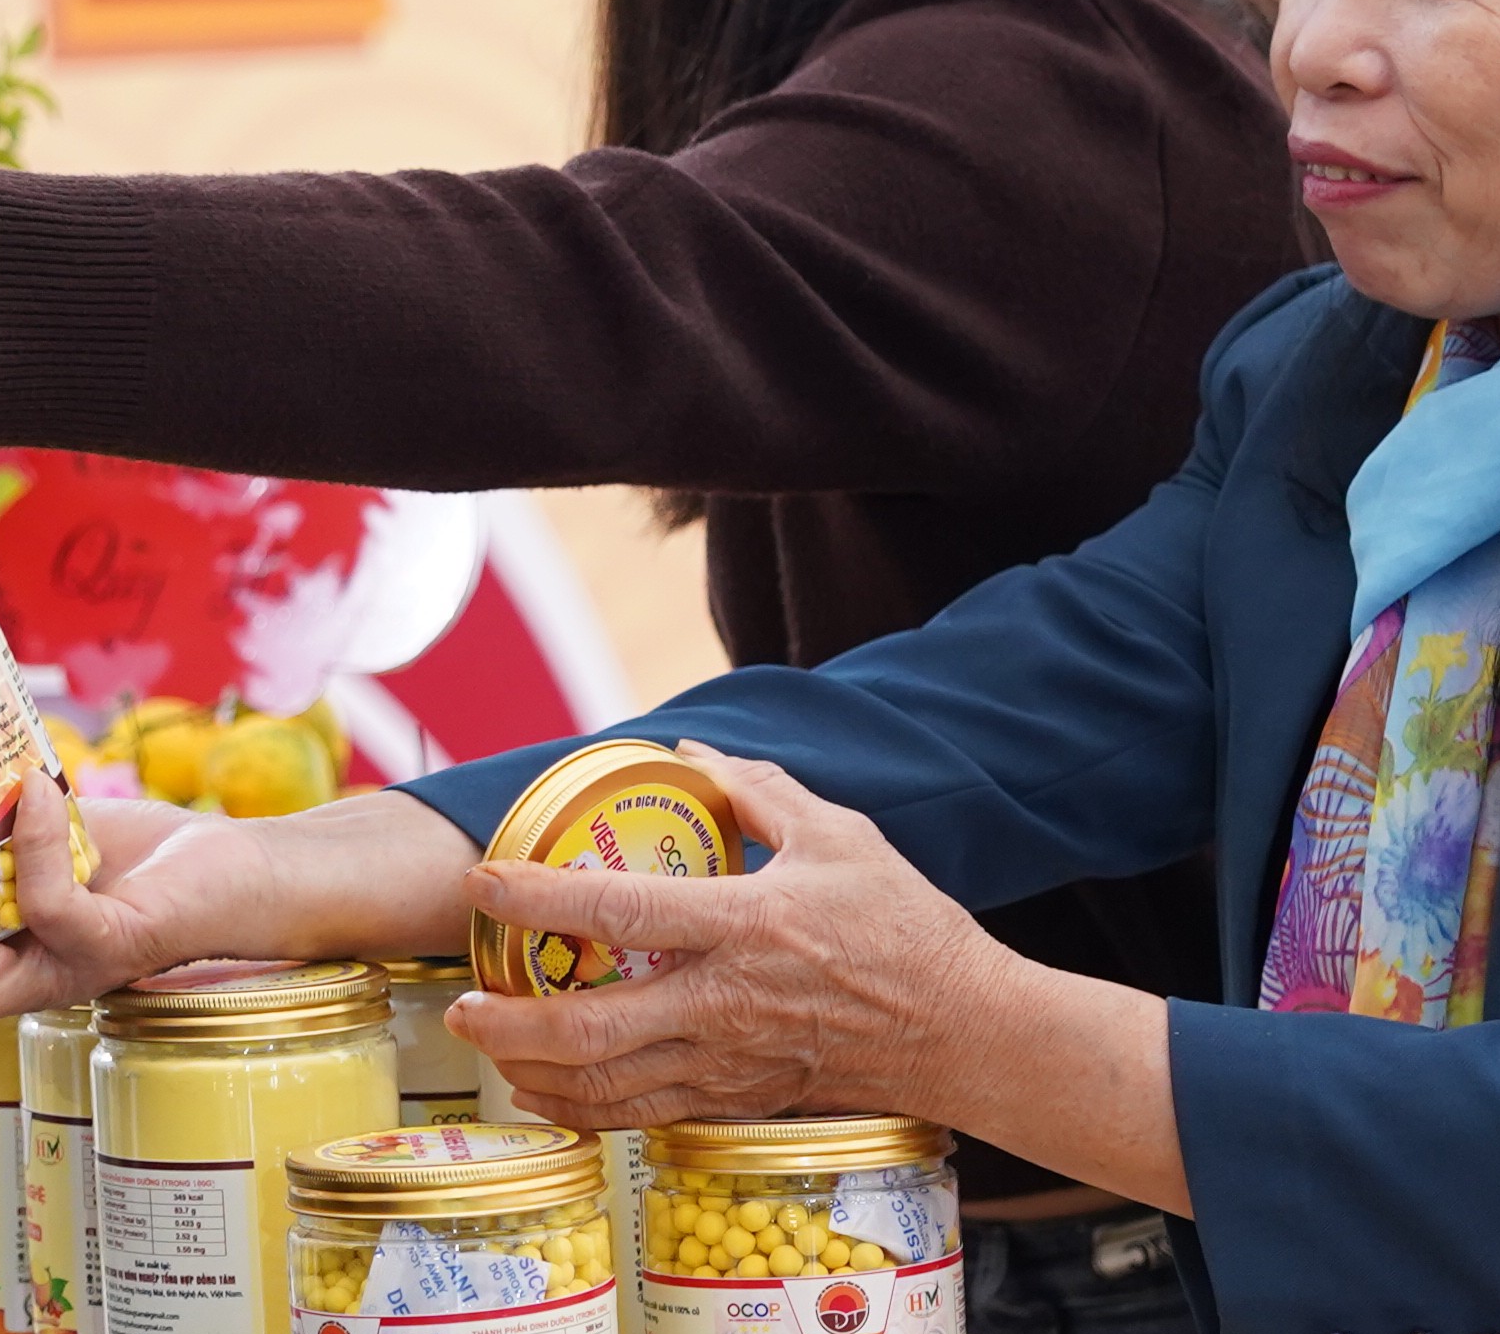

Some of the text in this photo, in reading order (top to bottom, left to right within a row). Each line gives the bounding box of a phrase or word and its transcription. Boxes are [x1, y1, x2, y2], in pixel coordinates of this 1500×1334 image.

[589, 812, 617, 862] VIÊN
[635, 795, 657, 809] DỊCH
[659, 797, 672, 812] VỤ
[672, 800, 695, 823] NÔNG
[691, 817, 715, 850] NGHIỆP
[660, 835, 688, 876] OCO
[727, 1302, 781, 1317] OCOP
